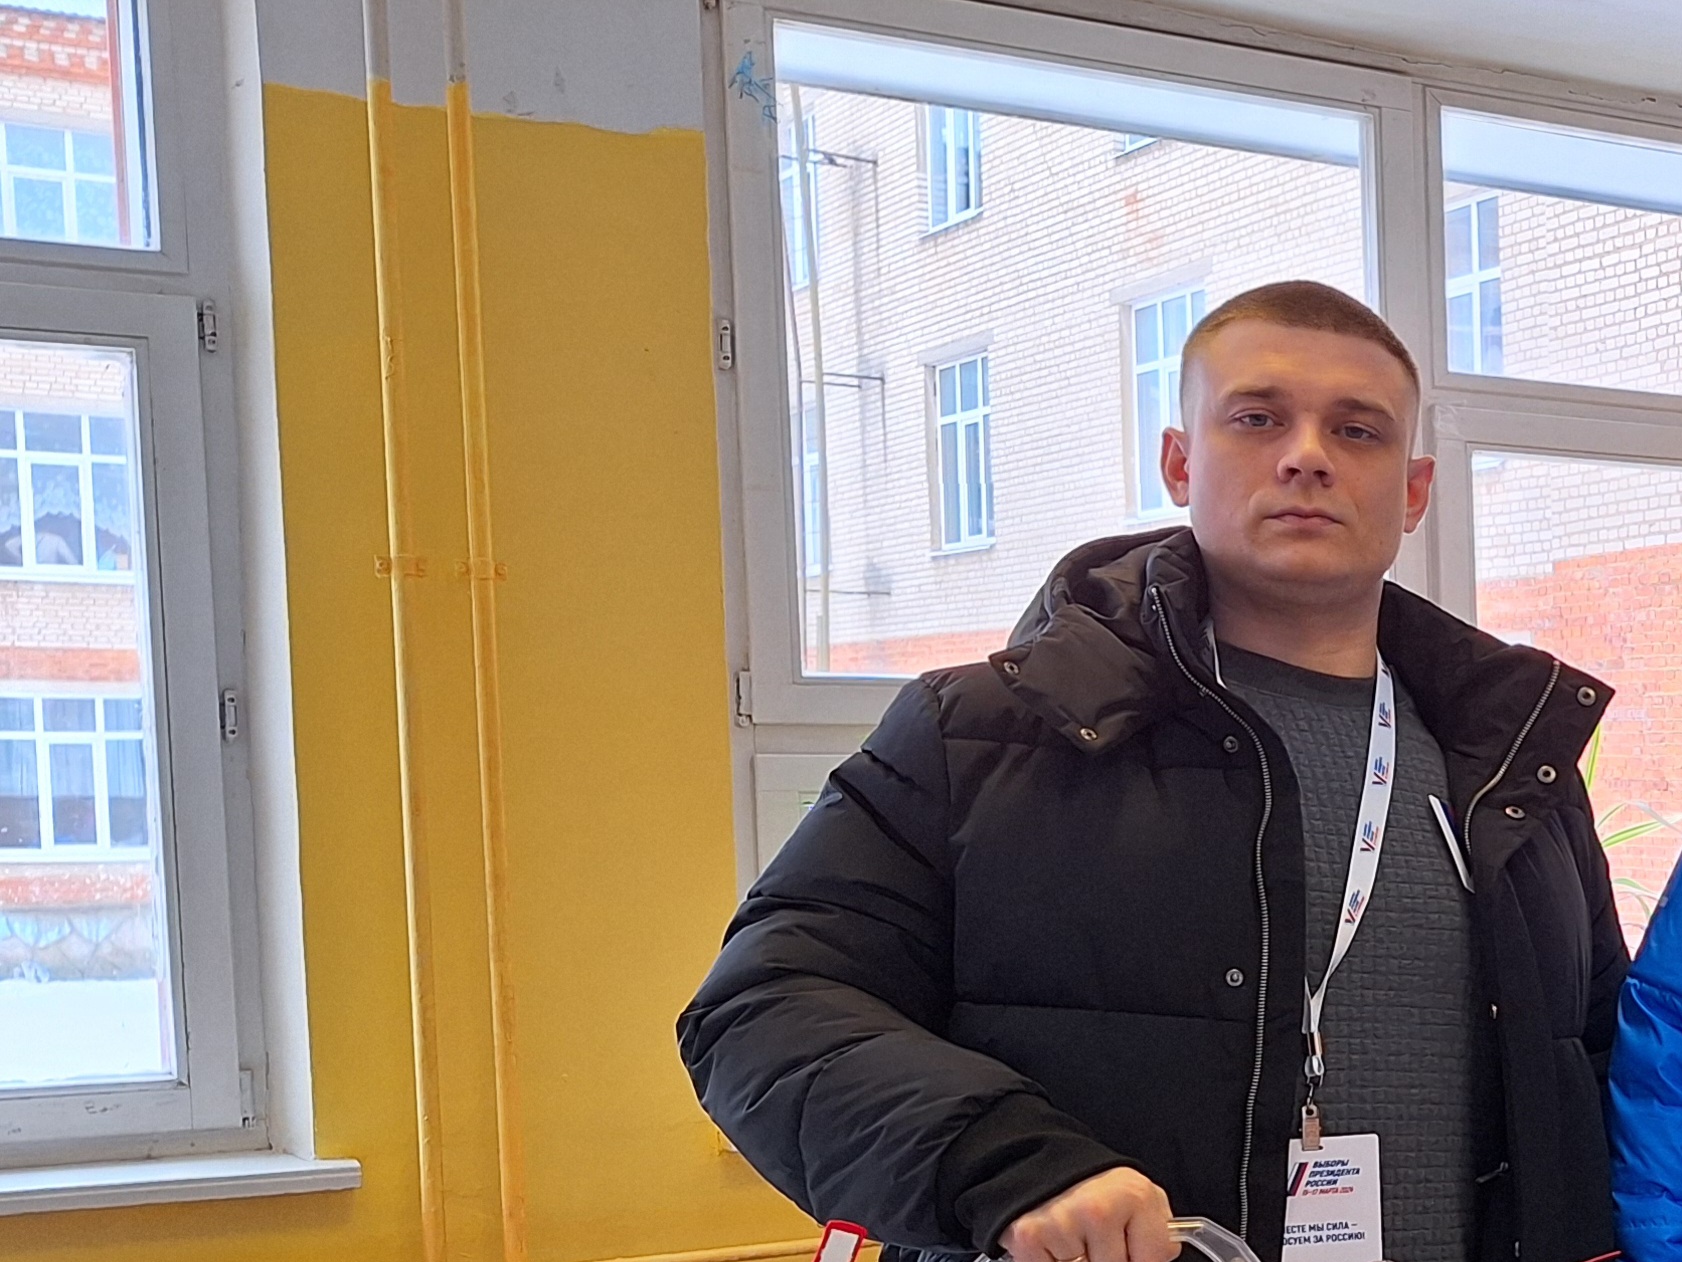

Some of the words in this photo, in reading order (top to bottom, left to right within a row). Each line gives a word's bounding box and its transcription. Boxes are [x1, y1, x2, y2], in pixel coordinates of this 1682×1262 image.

[1313, 1159, 1350, 1169] ВЫБОРЫ
[1308, 1168, 1360, 1178] ПРЕЗИДЕНТА
[1305, 1178, 1339, 1188] РОССИИ
[1308, 1223, 1324, 1232] МЫ
[1326, 1221, 1350, 1231] СИЛА
[1313, 1235, 1324, 1244] ЗА
[1326, 1231, 1365, 1242] РОССИЮ!
